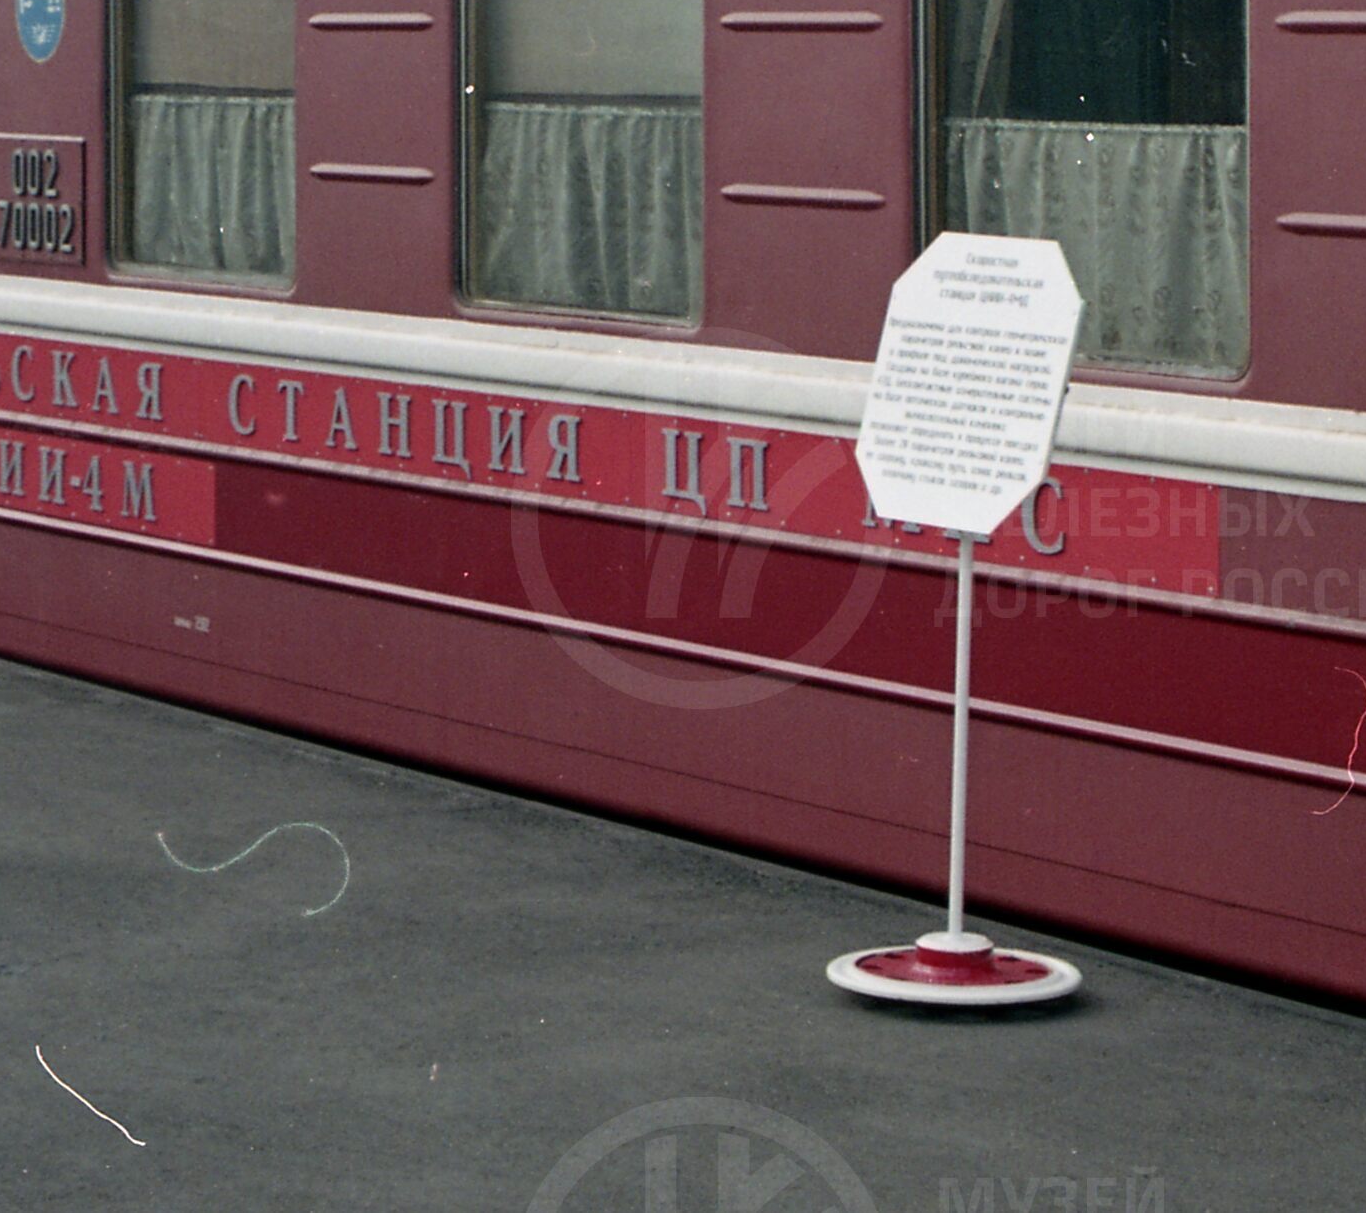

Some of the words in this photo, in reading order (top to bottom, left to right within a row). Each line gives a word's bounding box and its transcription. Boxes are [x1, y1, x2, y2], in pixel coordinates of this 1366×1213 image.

[11, 148, 59, 198] 002
[229, 375, 581, 483] СТАНЦИЯ
[662, 429, 768, 516] ЦП
